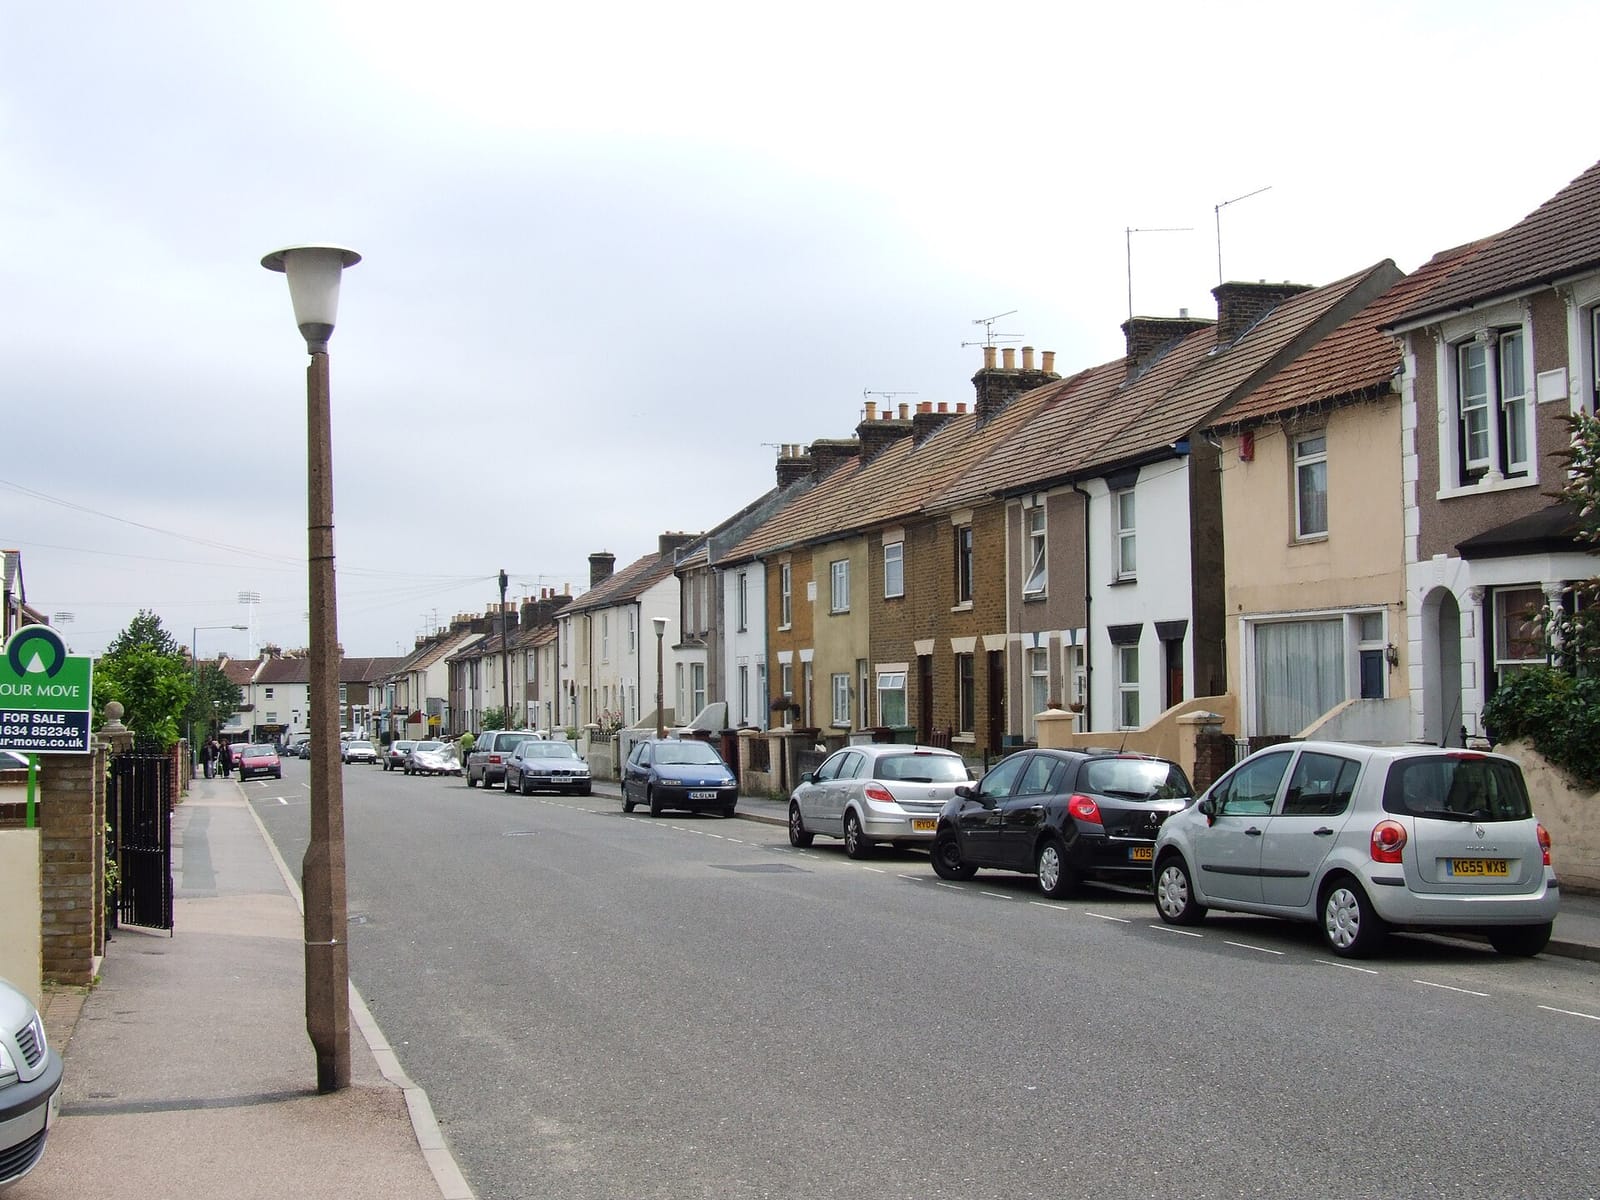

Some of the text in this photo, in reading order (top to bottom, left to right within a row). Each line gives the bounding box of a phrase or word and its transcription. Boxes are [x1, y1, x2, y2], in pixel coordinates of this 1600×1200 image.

[36, 684, 80, 697] MOVE
[3, 712, 65, 724] FOR SALE
[31, 726, 79, 737] 852345
[1134, 848, 1153, 858] YD5
[1453, 860, 1507, 873] KG55 WXB
